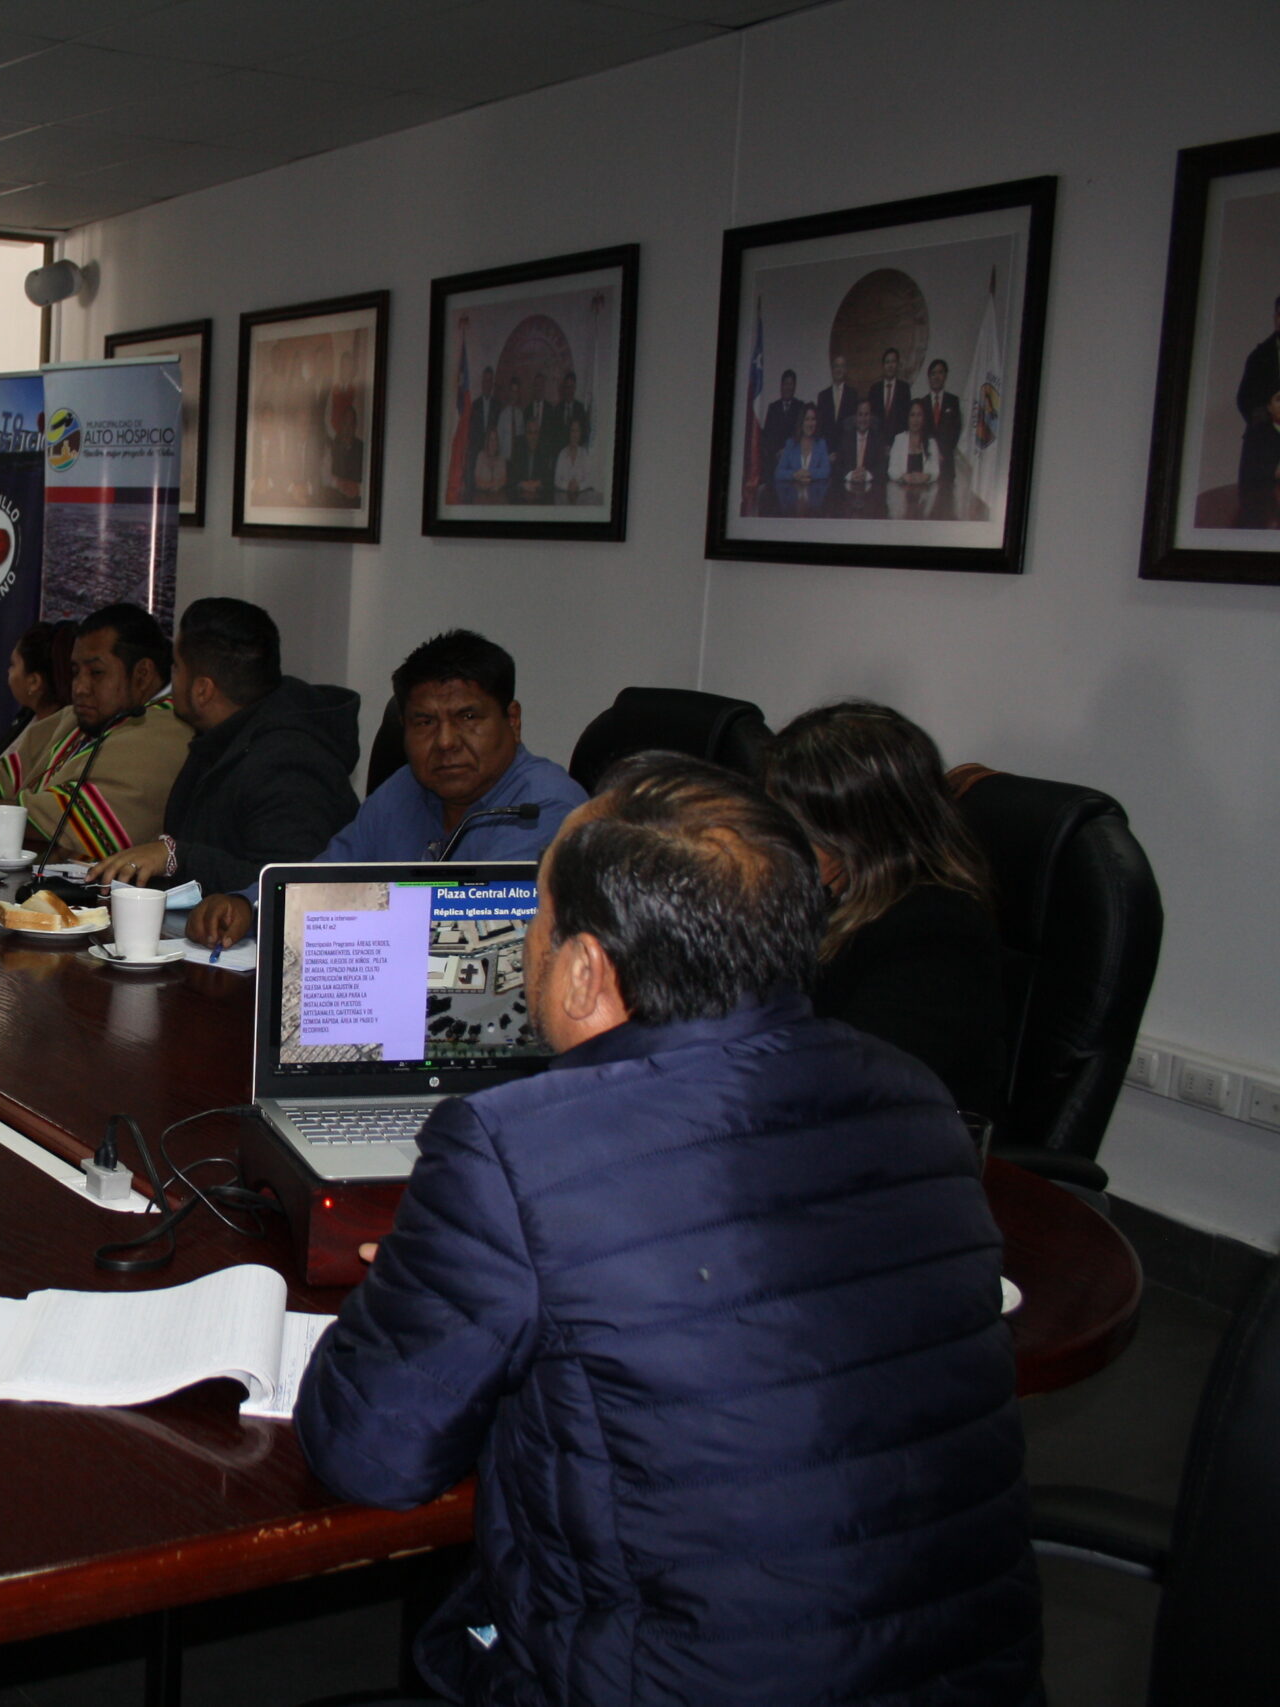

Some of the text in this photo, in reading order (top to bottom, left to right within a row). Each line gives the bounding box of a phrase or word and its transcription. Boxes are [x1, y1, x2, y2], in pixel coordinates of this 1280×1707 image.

[84, 428, 176, 445] ALTO HOSPICIO
[437, 888, 466, 899] Plaza
[468, 887, 506, 898] Central
[508, 887, 530, 898] Alto
[434, 906, 538, 917] Réplica Iglesia San Agustí
